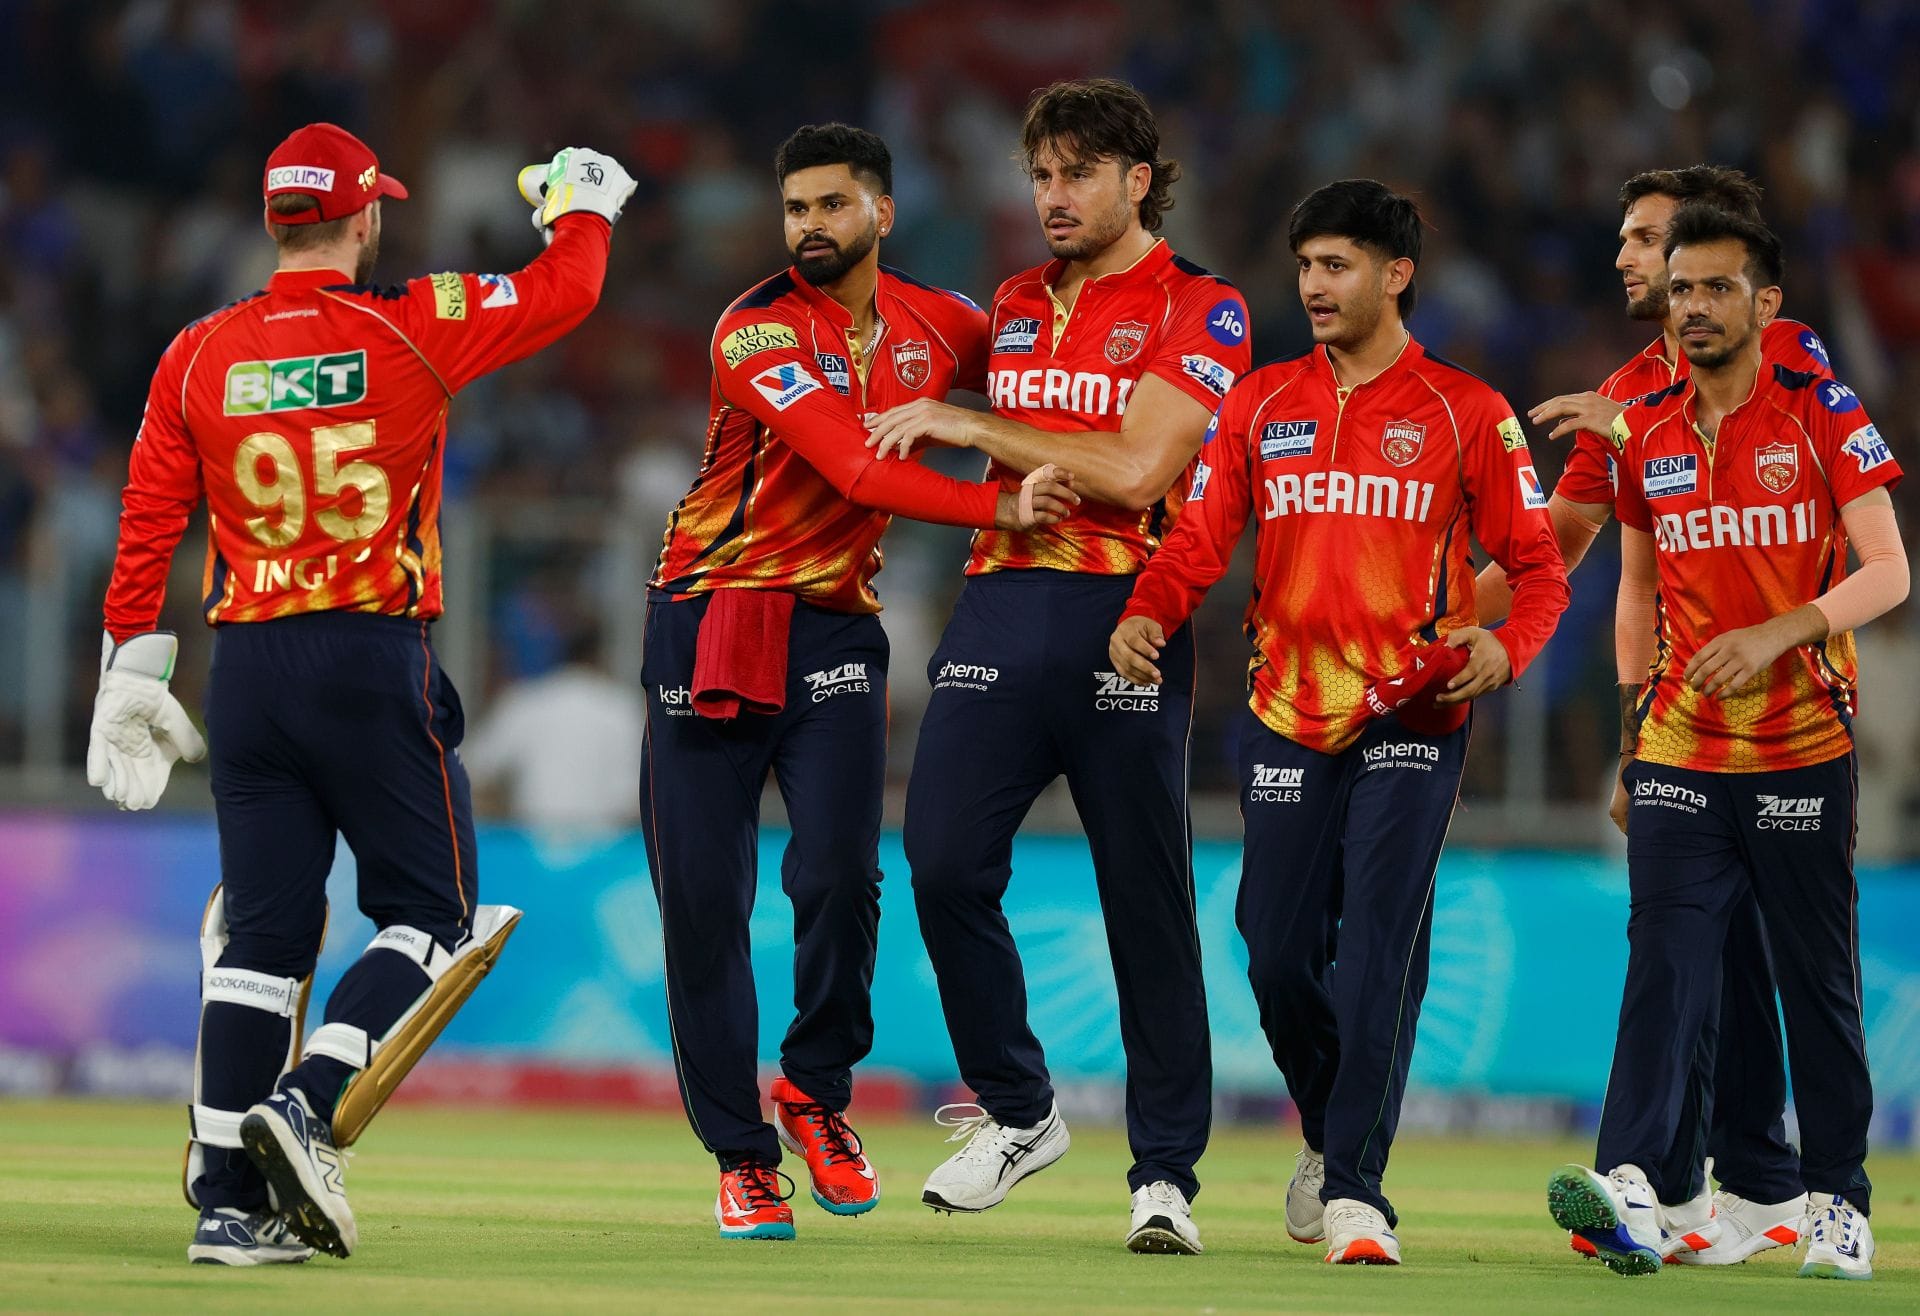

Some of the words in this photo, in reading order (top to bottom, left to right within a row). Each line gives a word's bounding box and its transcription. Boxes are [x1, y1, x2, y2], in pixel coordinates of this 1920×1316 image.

[270, 169, 330, 187] ECOLINK
[735, 324, 766, 343] ALL
[1003, 319, 1033, 333] KENT
[1212, 311, 1243, 338] Jio
[1112, 328, 1144, 341] KINGS
[724, 331, 797, 366] SEASONS
[896, 349, 927, 364] KINGS
[817, 355, 843, 371] KEN
[229, 362, 360, 405] BKT
[1267, 422, 1309, 439] KENT
[1385, 428, 1421, 444] KINGS
[1651, 456, 1688, 476] KENT
[1758, 452, 1794, 468] KINGS
[233, 418, 392, 549] 95
[1648, 477, 1675, 487] Mineral
[1265, 470, 1435, 523] DREAM11
[1654, 498, 1816, 553] DREAM11
[803, 663, 867, 690] AVON
[936, 660, 999, 682] shema
[659, 684, 692, 704] ksh
[811, 681, 870, 703] CYCLES
[665, 707, 693, 716] General
[1095, 698, 1159, 712] CYCLES
[1363, 740, 1440, 763] kshema
[1252, 763, 1305, 787] AVON
[1395, 760, 1432, 772] Insurance
[1250, 789, 1302, 803] CYCLES
[1633, 778, 1707, 808] kshema
[1634, 798, 1658, 806] General
[1658, 798, 1697, 814] Insurance
[1756, 795, 1825, 816] AVON
[1756, 818, 1821, 831] CYCLES
